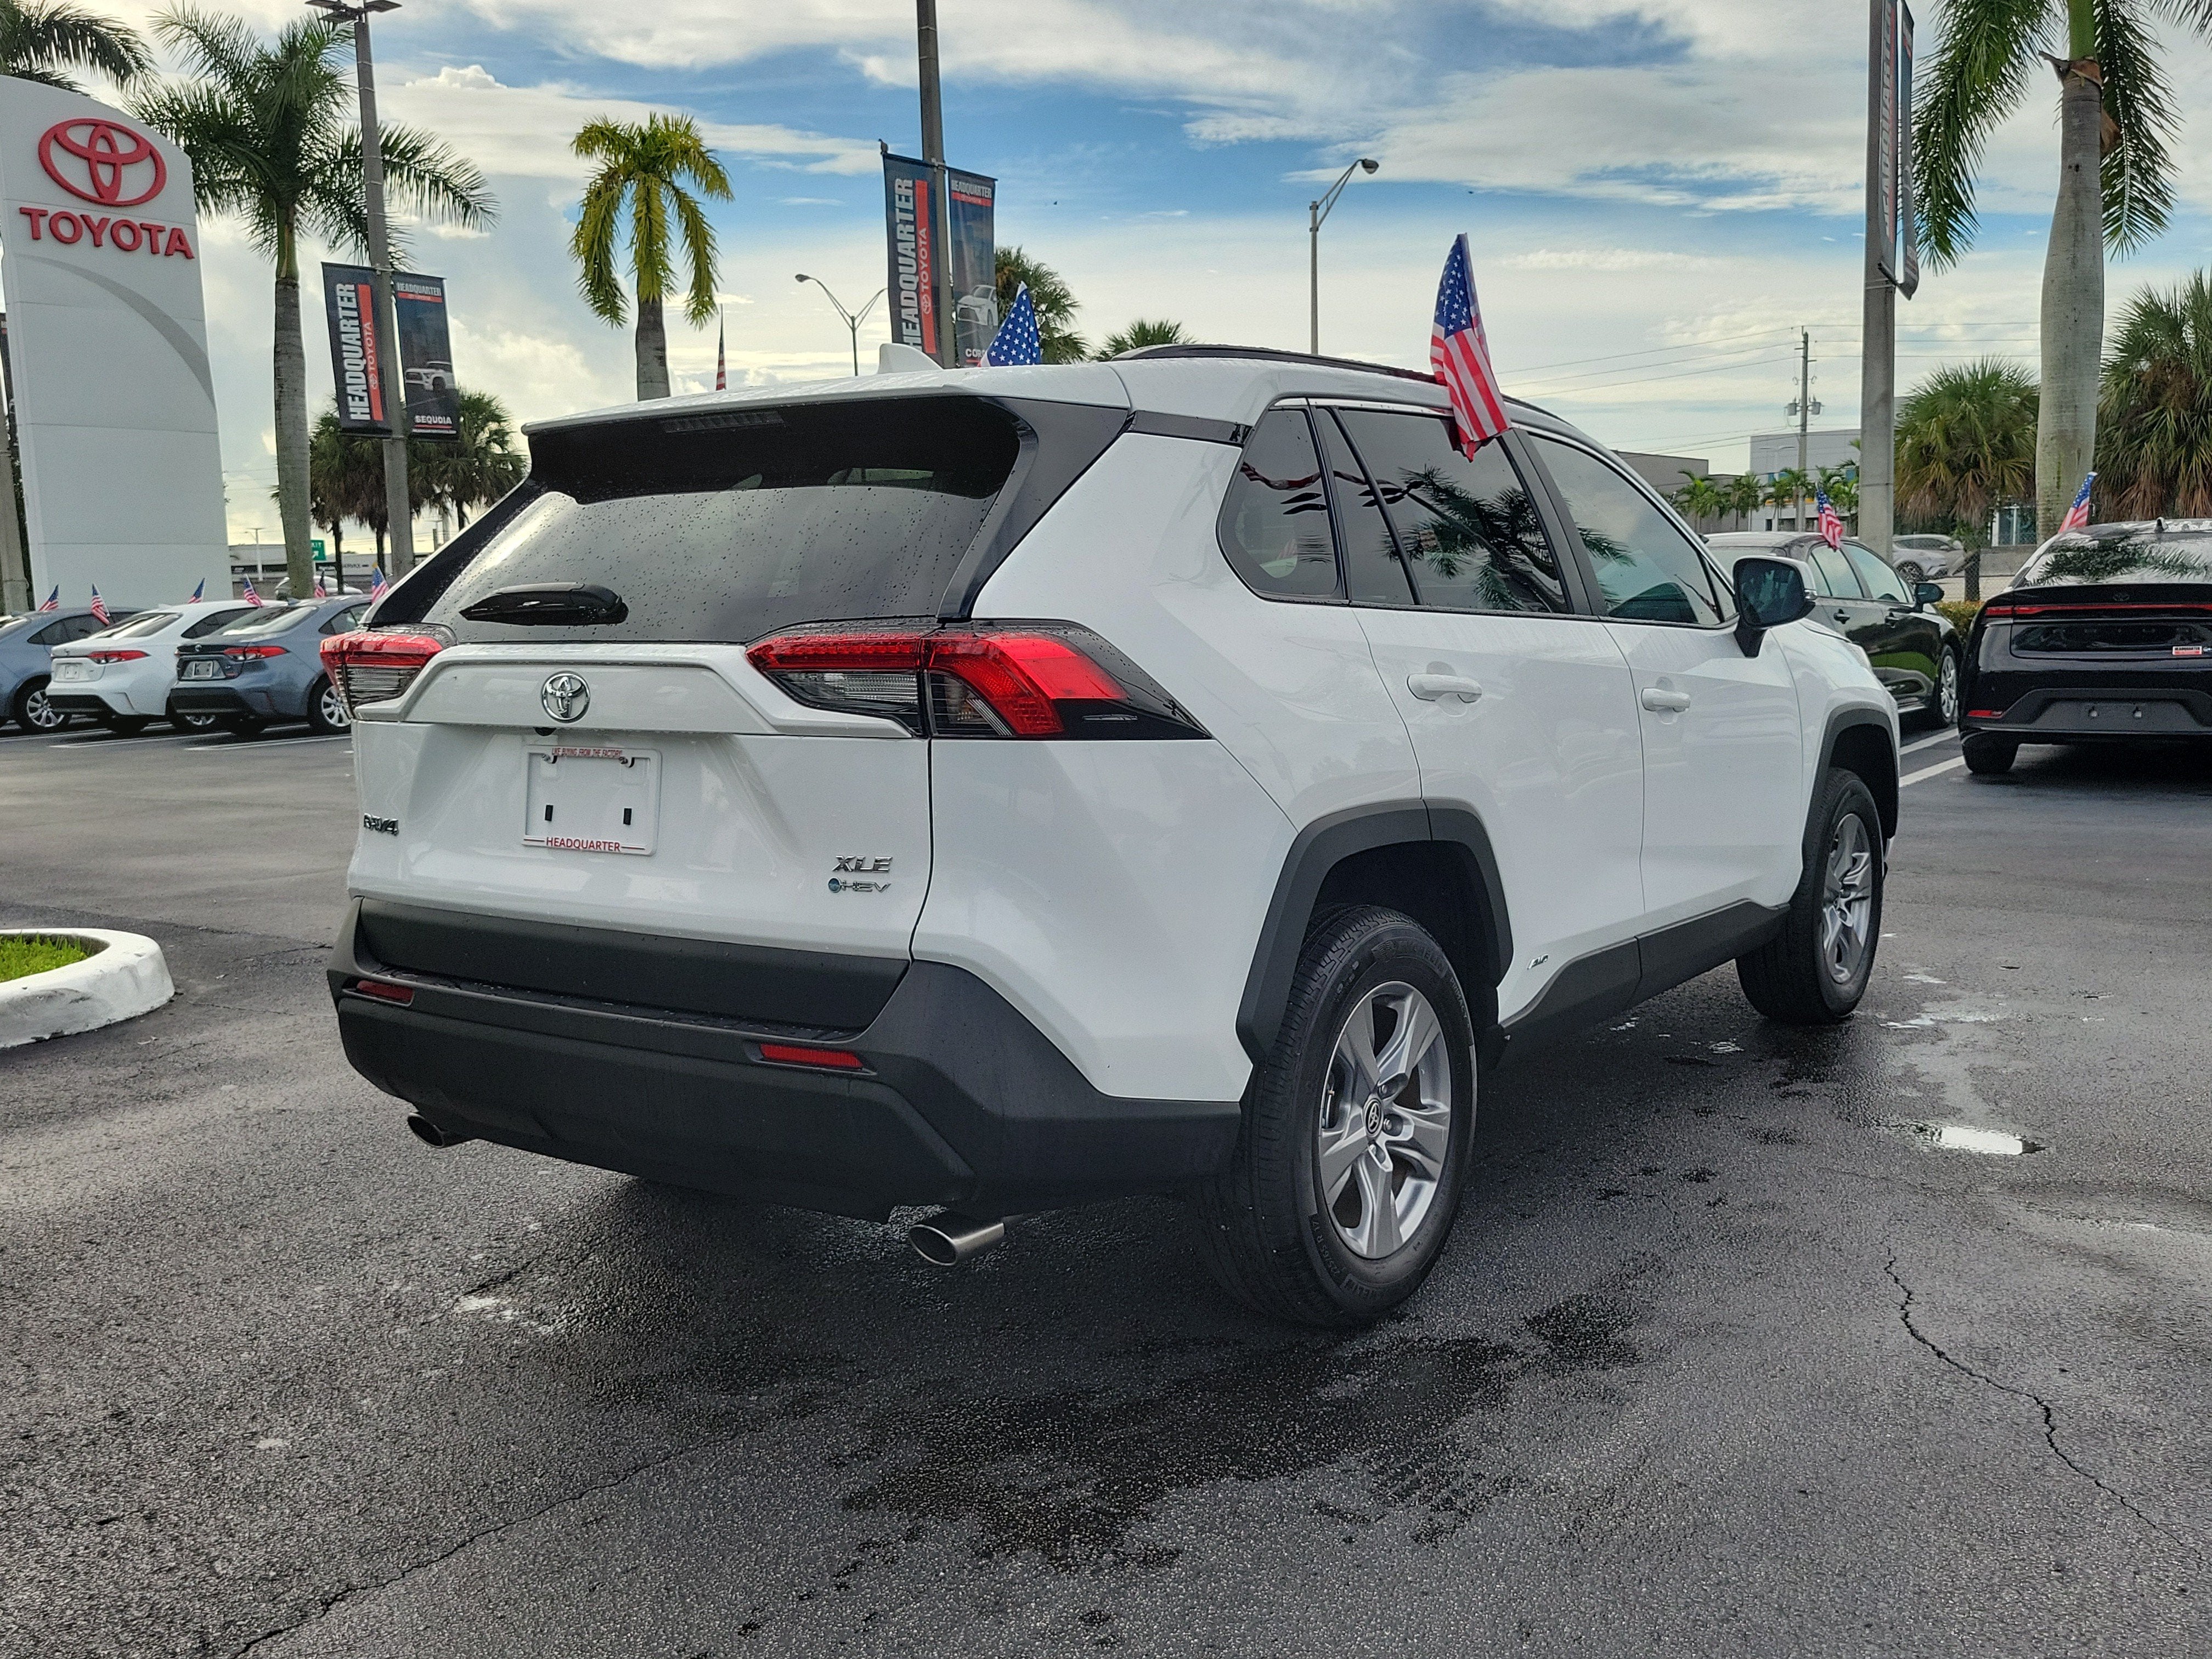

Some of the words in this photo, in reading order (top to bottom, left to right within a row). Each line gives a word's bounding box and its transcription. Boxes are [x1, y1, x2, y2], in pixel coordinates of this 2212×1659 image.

[19, 207, 195, 259] TOYOTA
[895, 178, 922, 352] HEADQUARTER
[919, 228, 929, 292] TOYOTA
[336, 284, 371, 420] HEADQUARTER
[364, 322, 375, 370] TOYOTA
[415, 415, 453, 424] SEQUOIA
[546, 837, 620, 851] HEADQUARTER
[832, 855, 893, 873] XLE
